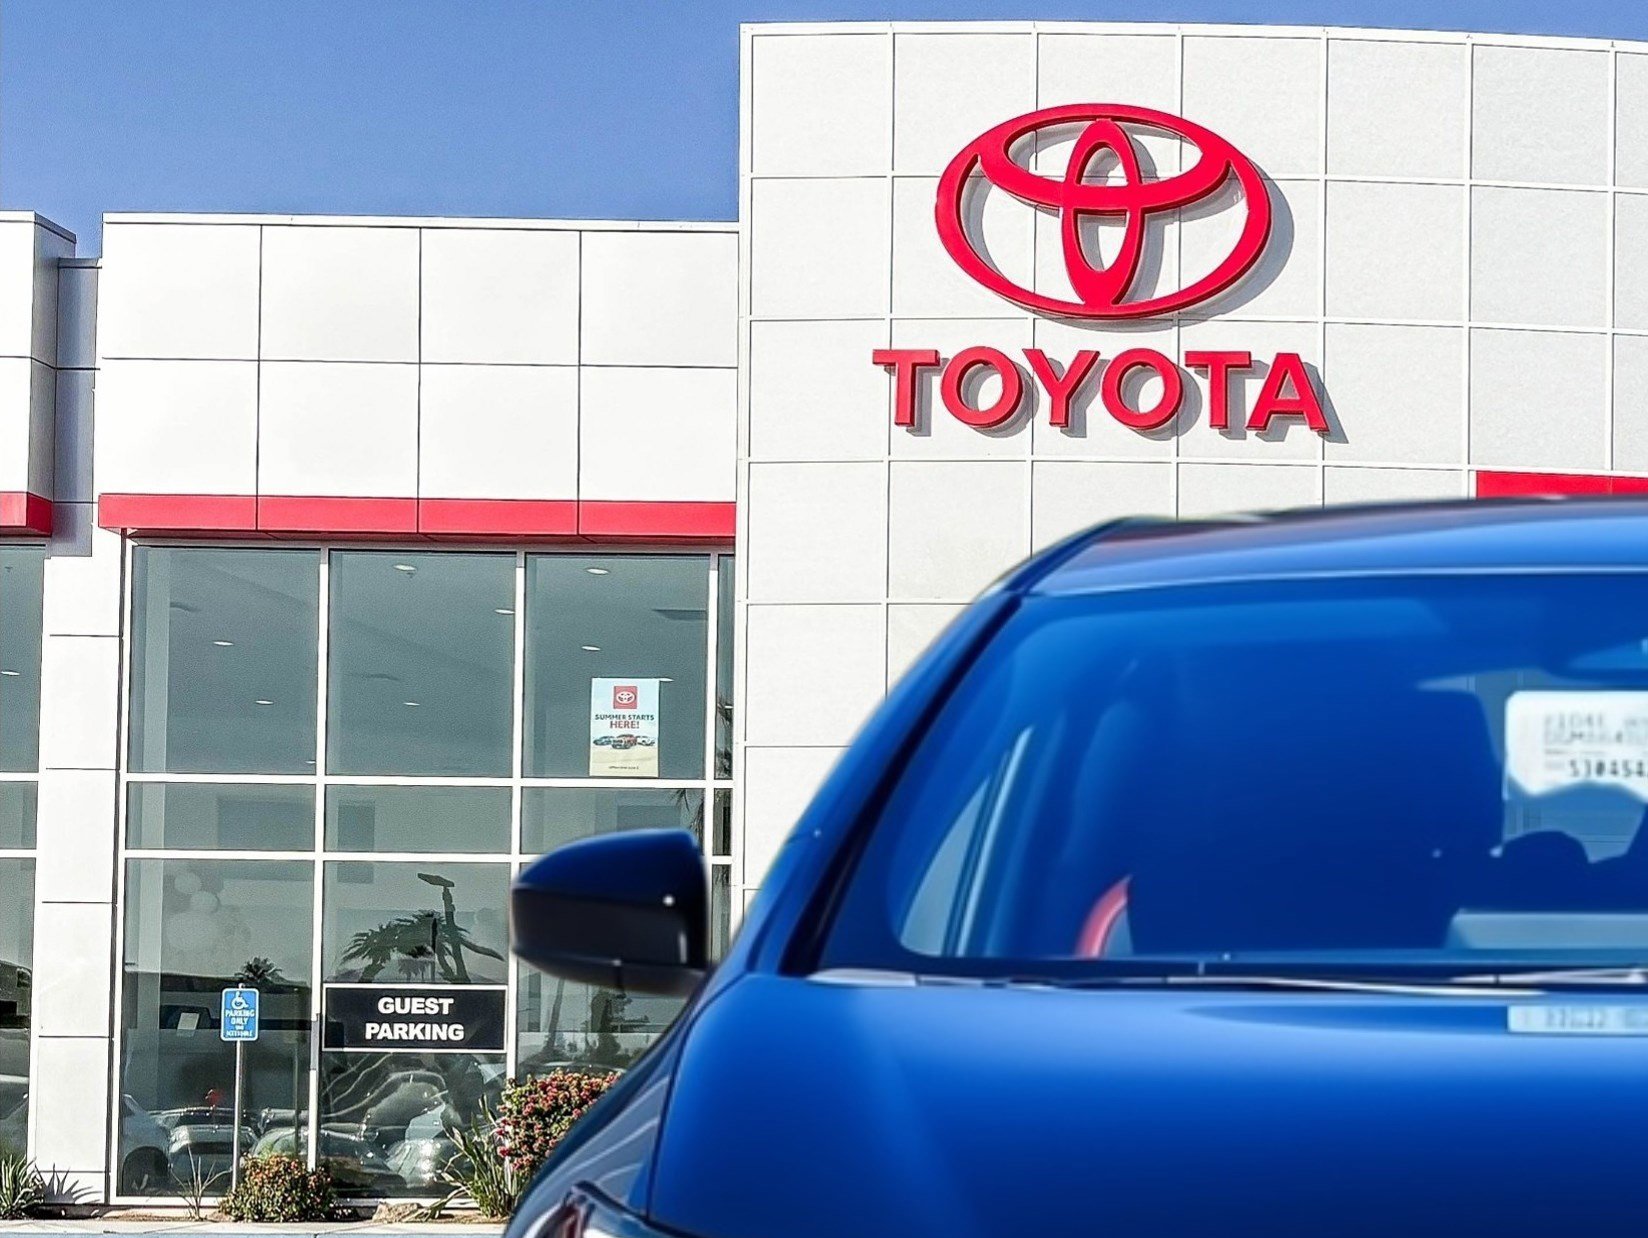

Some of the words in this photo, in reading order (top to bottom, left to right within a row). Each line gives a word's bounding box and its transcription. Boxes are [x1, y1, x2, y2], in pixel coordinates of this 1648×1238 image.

[872, 346, 1329, 433] TOYOTA
[610, 721, 640, 729] HERE!
[378, 997, 454, 1015] GUEST
[225, 1009, 255, 1017] PARKING
[231, 1017, 249, 1025] ONLY
[365, 1023, 465, 1041] PARKING
